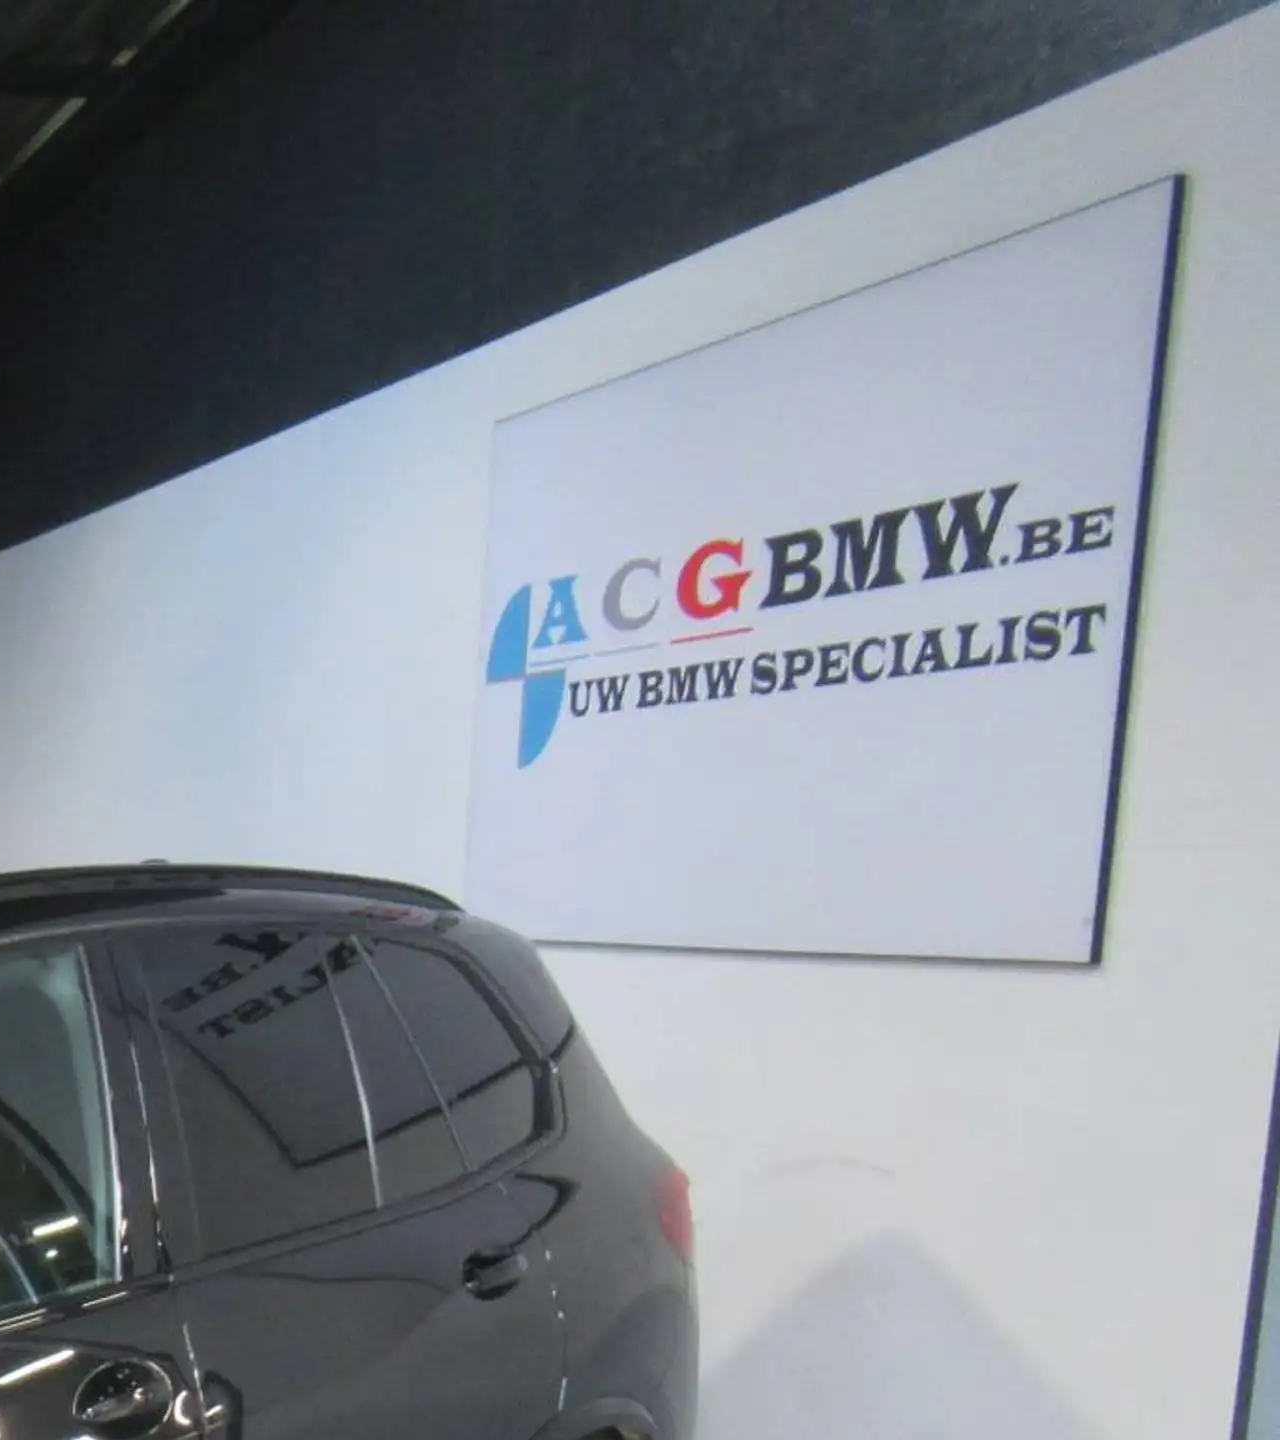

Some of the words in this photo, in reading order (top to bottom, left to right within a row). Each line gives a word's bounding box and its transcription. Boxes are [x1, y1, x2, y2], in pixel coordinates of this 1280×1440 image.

[568, 677, 629, 718] UW
[636, 658, 744, 711] BMW
[750, 603, 1108, 696] SPECIALIST
